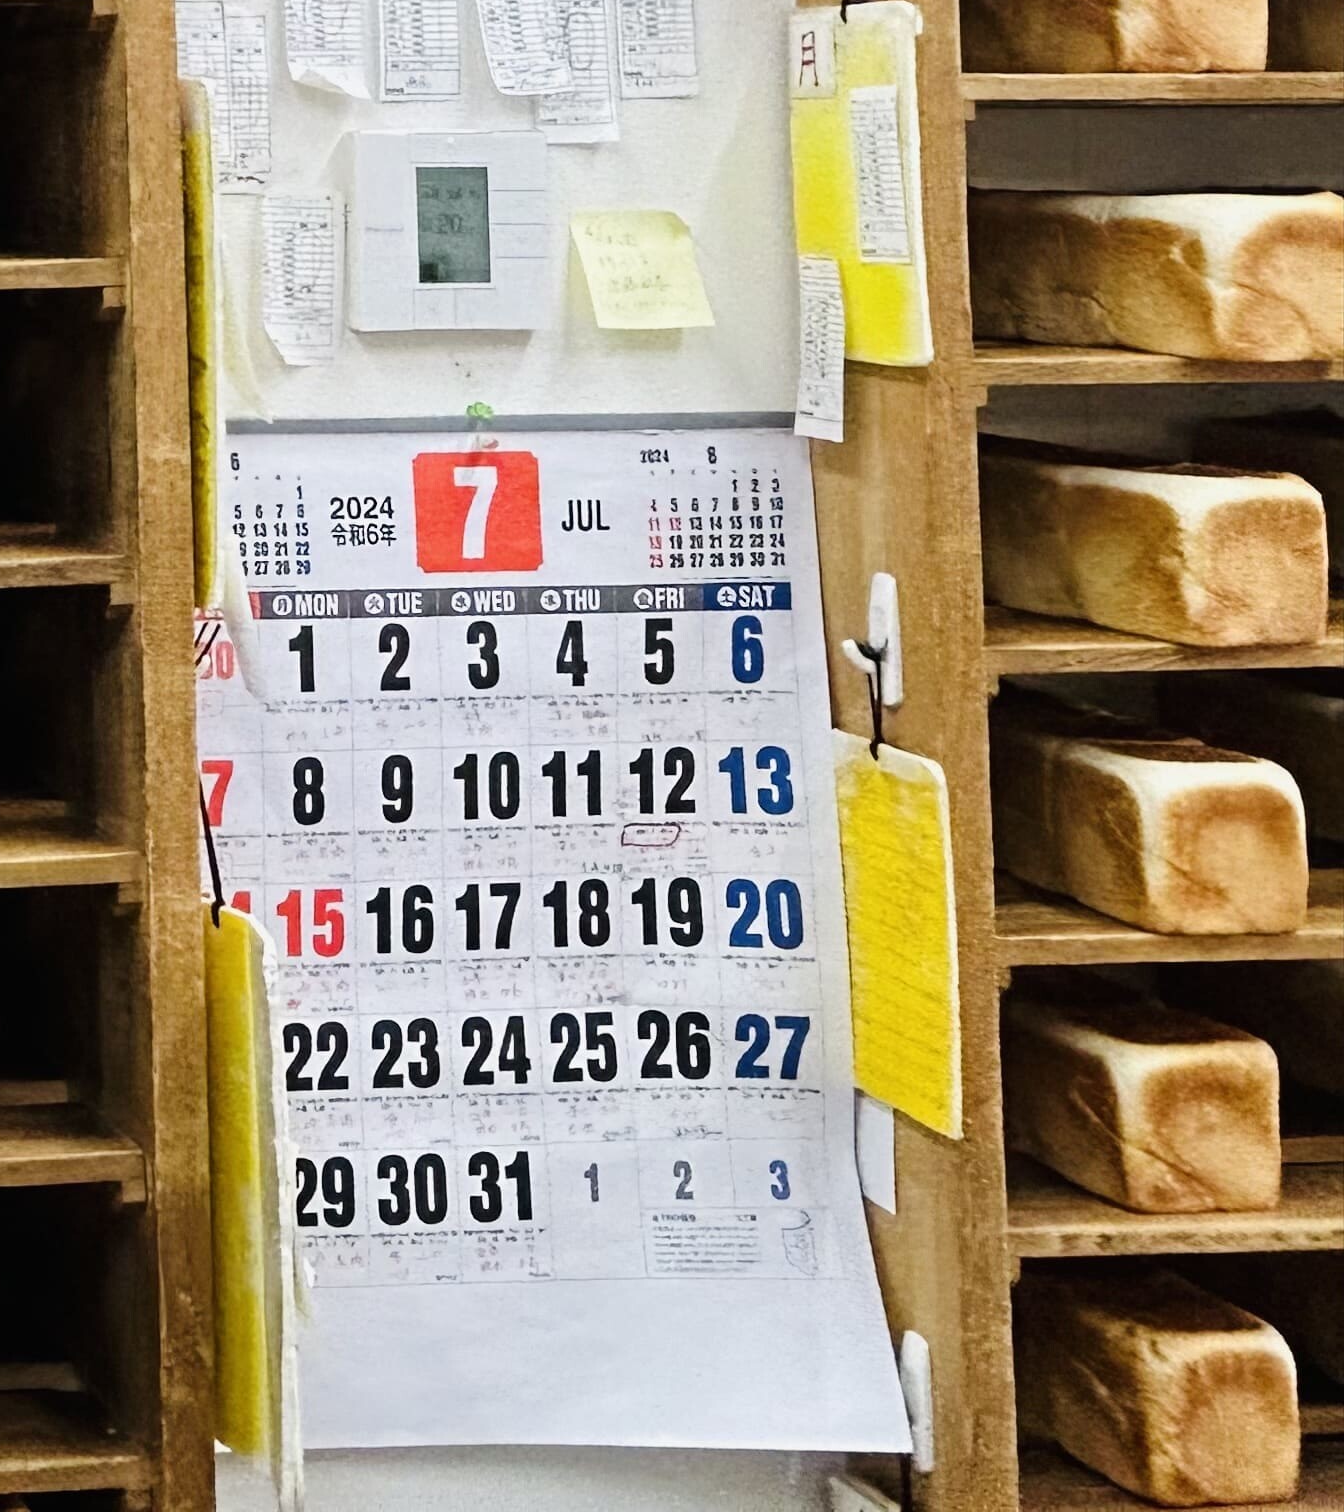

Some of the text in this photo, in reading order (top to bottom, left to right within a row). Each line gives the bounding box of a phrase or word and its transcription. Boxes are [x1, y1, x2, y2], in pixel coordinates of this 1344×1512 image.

[707, 446, 717, 464] 8
[330, 496, 395, 520] 2024
[453, 466, 498, 559] 7
[561, 499, 611, 532] JUL
[330, 522, 397, 547] 令和6年
[295, 593, 338, 616] MON
[386, 591, 423, 615] TUE
[473, 590, 516, 613] WED
[563, 588, 601, 612] THU
[654, 587, 685, 609] FRI
[738, 585, 775, 608] SAT
[288, 625, 316, 693] 1
[378, 623, 411, 692] 2
[466, 620, 500, 690] 3
[556, 620, 589, 687] 4
[643, 617, 675, 685] 5
[731, 614, 765, 684] 6
[201, 745, 794, 827] 7 8 9 10 11 12 13
[276, 876, 804, 958] 15 16 17 18 19 20
[282, 1009, 811, 1092] 22 23 24 25 26 27
[295, 1150, 791, 1228] 29 30 31 1 2 3
